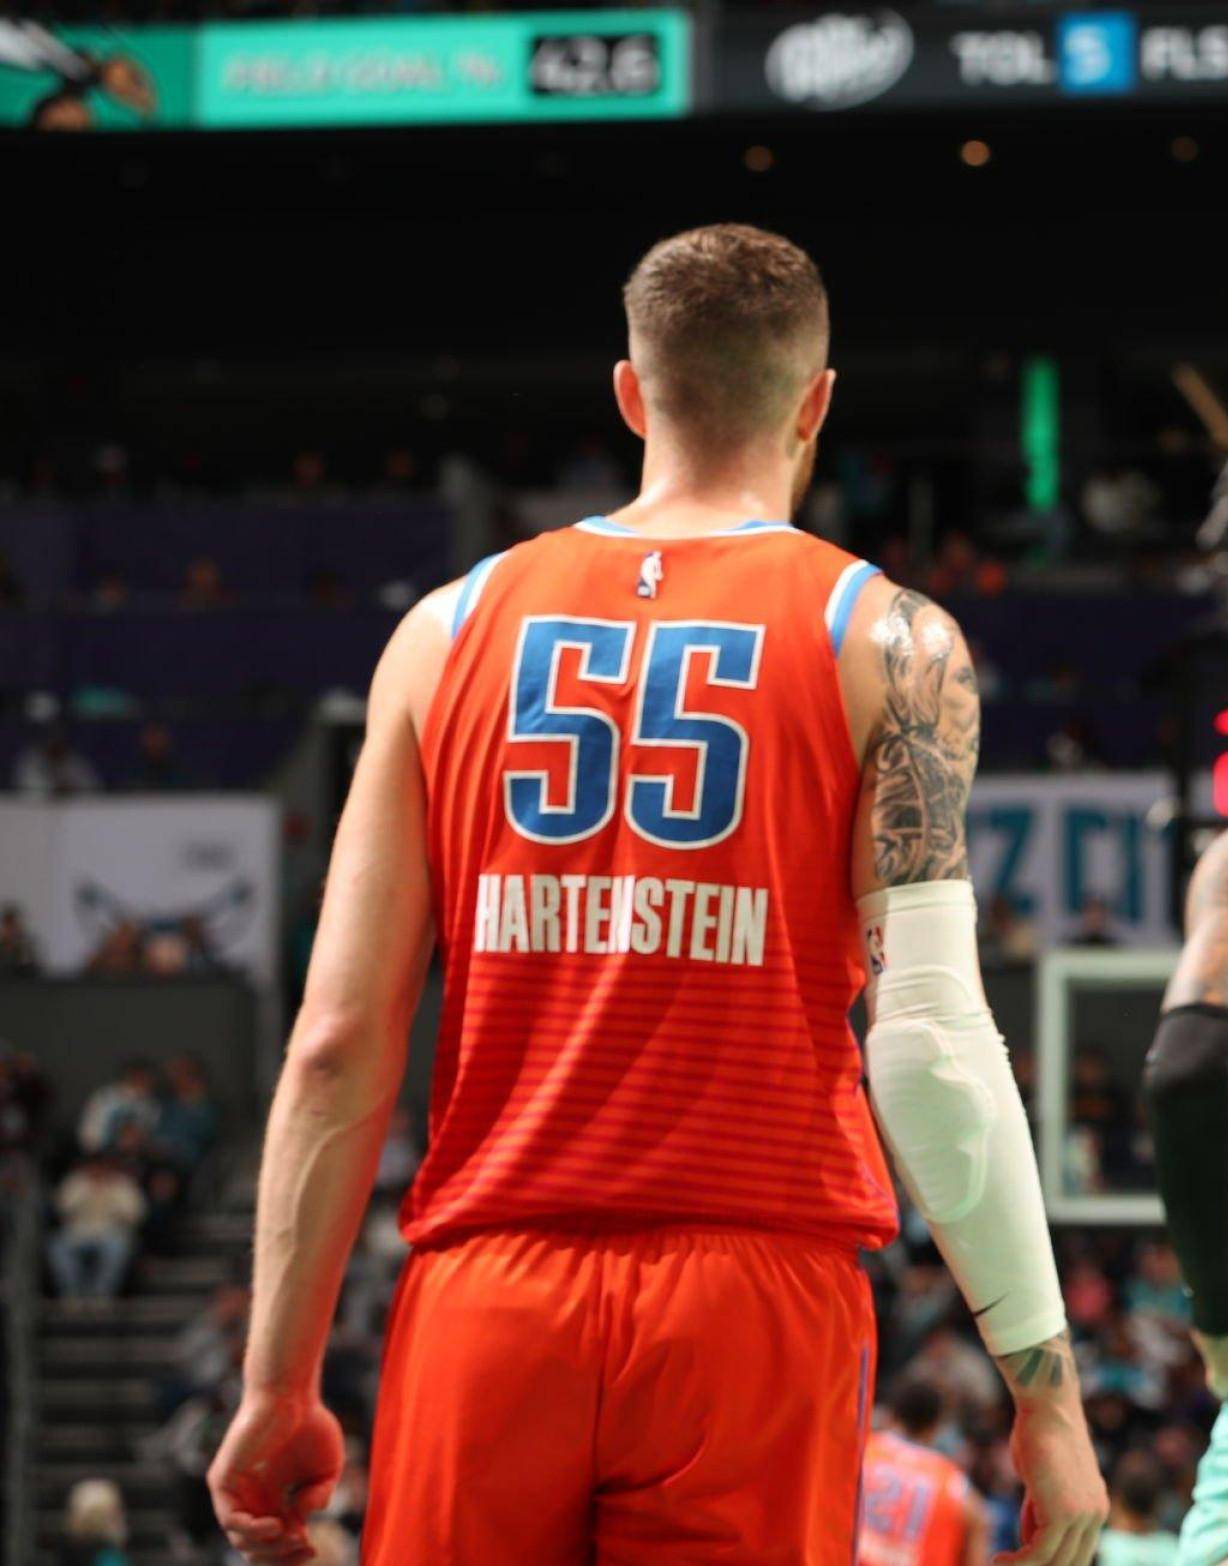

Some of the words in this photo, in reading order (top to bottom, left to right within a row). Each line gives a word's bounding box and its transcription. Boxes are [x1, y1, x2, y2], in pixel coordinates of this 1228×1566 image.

[950, 30, 1055, 86] TOL
[502, 614, 765, 851] 55
[474, 873, 768, 967] HARTENSTEIN
